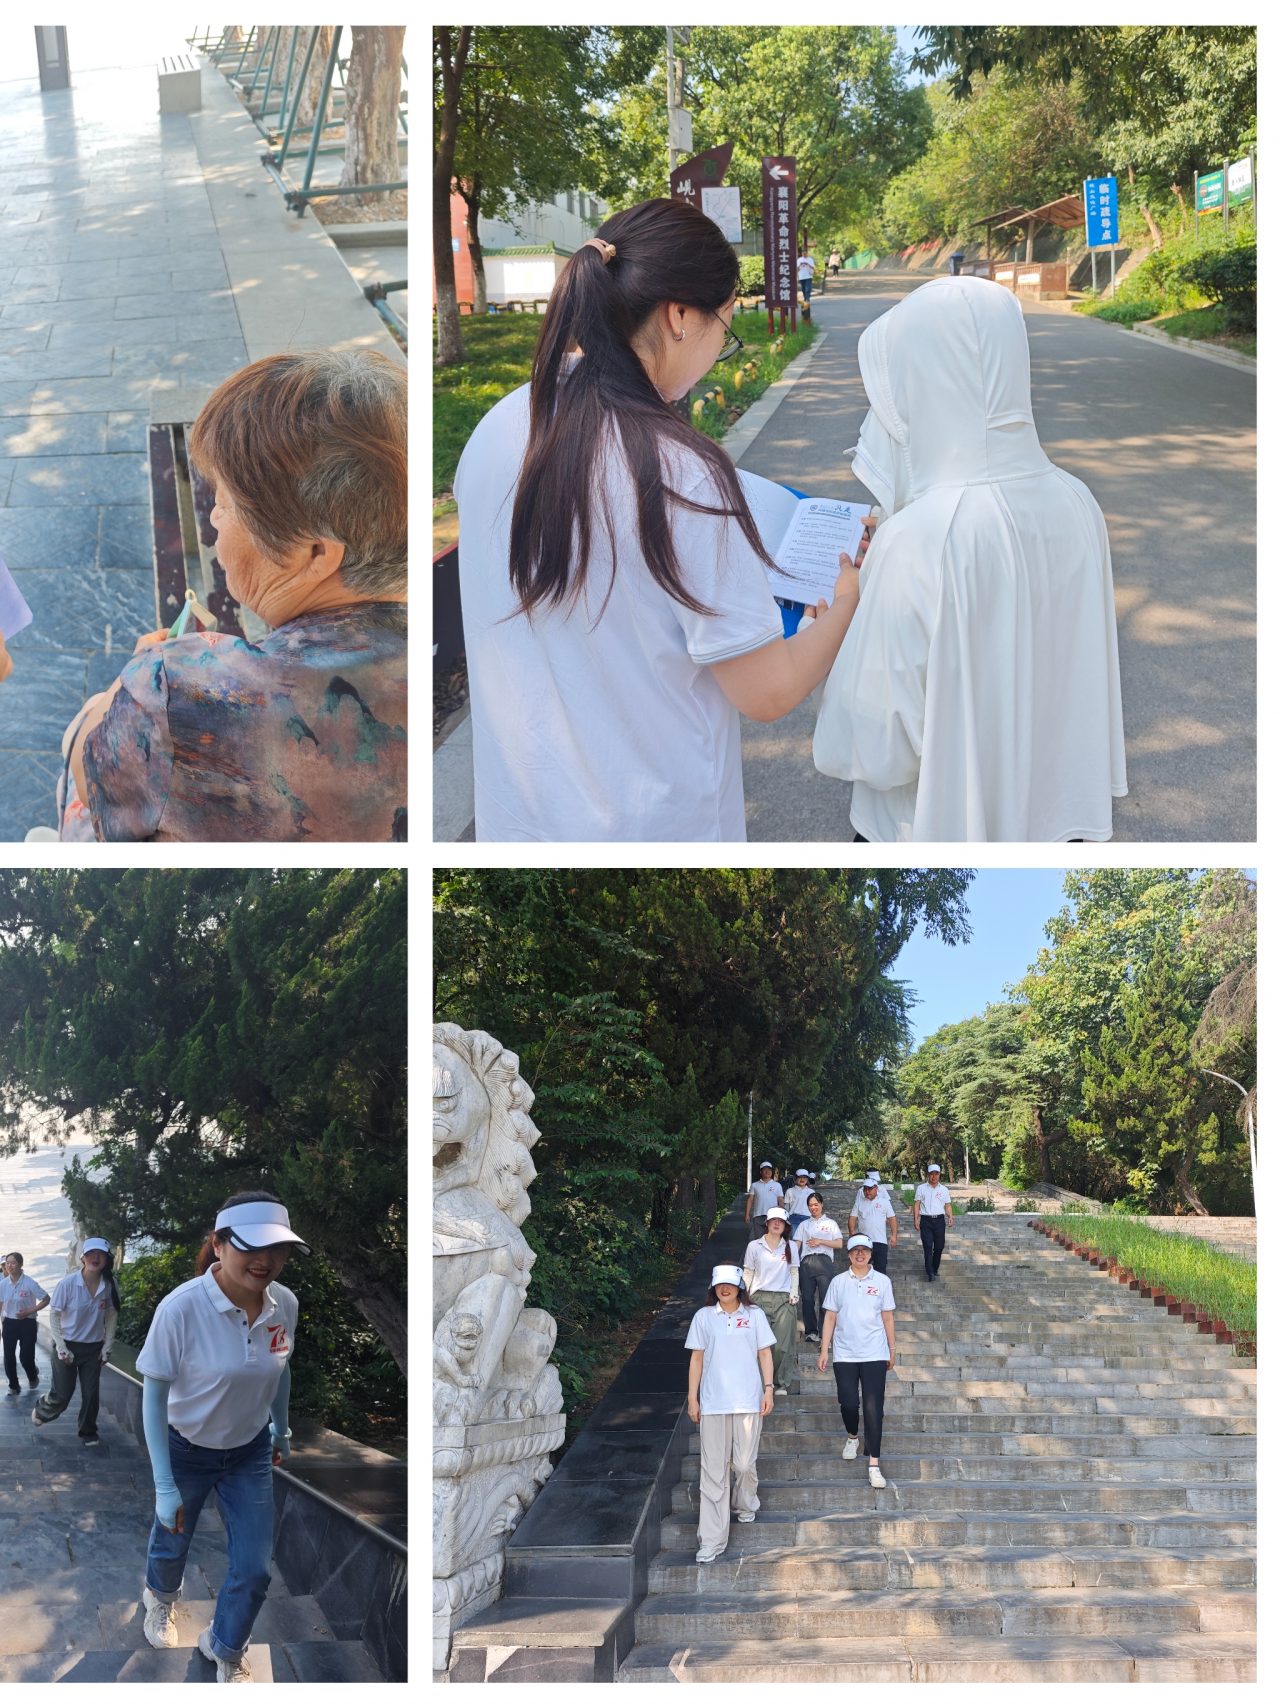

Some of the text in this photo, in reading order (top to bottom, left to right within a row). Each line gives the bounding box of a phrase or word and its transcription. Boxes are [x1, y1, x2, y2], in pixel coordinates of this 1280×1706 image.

[778, 186, 791, 301] 襄阳革命烈士纪念馆
[1098, 183, 1112, 241] 临时疏导点
